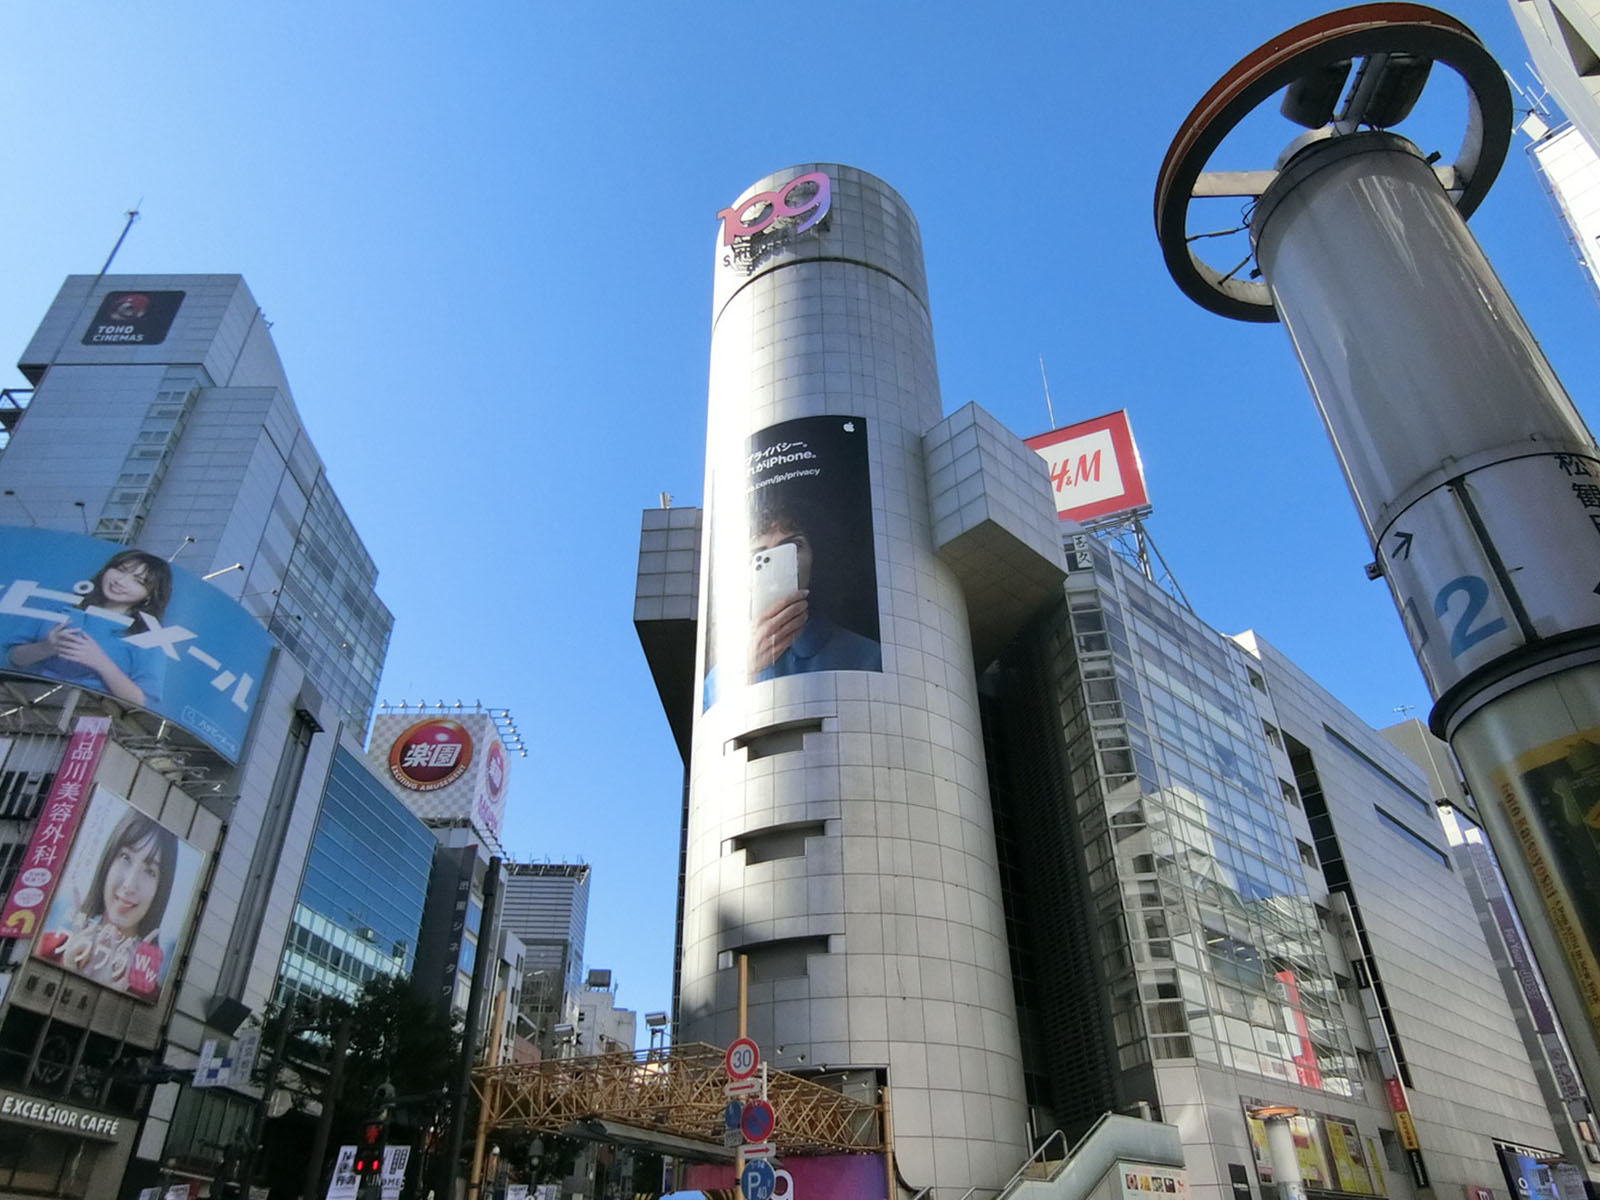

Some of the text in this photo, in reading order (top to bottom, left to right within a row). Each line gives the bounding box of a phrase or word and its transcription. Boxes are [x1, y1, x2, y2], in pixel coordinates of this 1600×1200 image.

[717, 172, 831, 247] 109
[93, 333, 144, 343] CINEMAS
[98, 325, 134, 334] TOHO
[0, 579, 254, 713] ピーメール
[402, 742, 462, 768] 楽園
[419, 764, 467, 791] AMUSEMENT
[32, 741, 94, 866] 品川美容外科
[733, 1049, 751, 1069] 30
[2, 1096, 120, 1136] EXCELSIOR CAFFÉ
